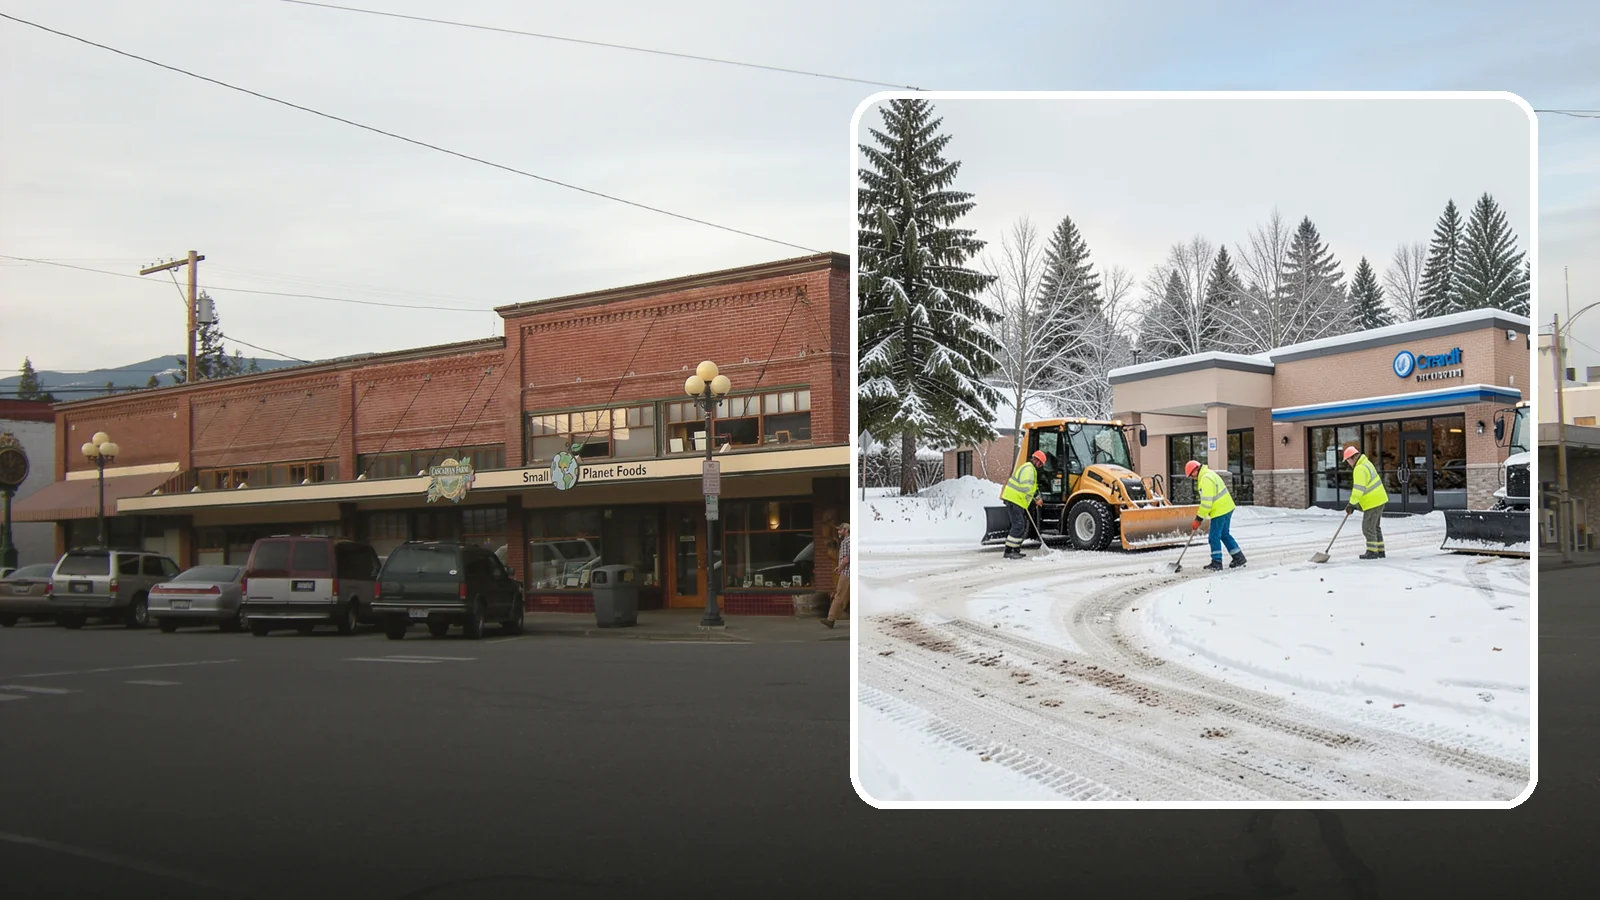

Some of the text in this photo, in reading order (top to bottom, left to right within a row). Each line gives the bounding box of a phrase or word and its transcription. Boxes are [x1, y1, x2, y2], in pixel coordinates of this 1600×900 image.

[523, 464, 647, 483] Small Planet Foods
